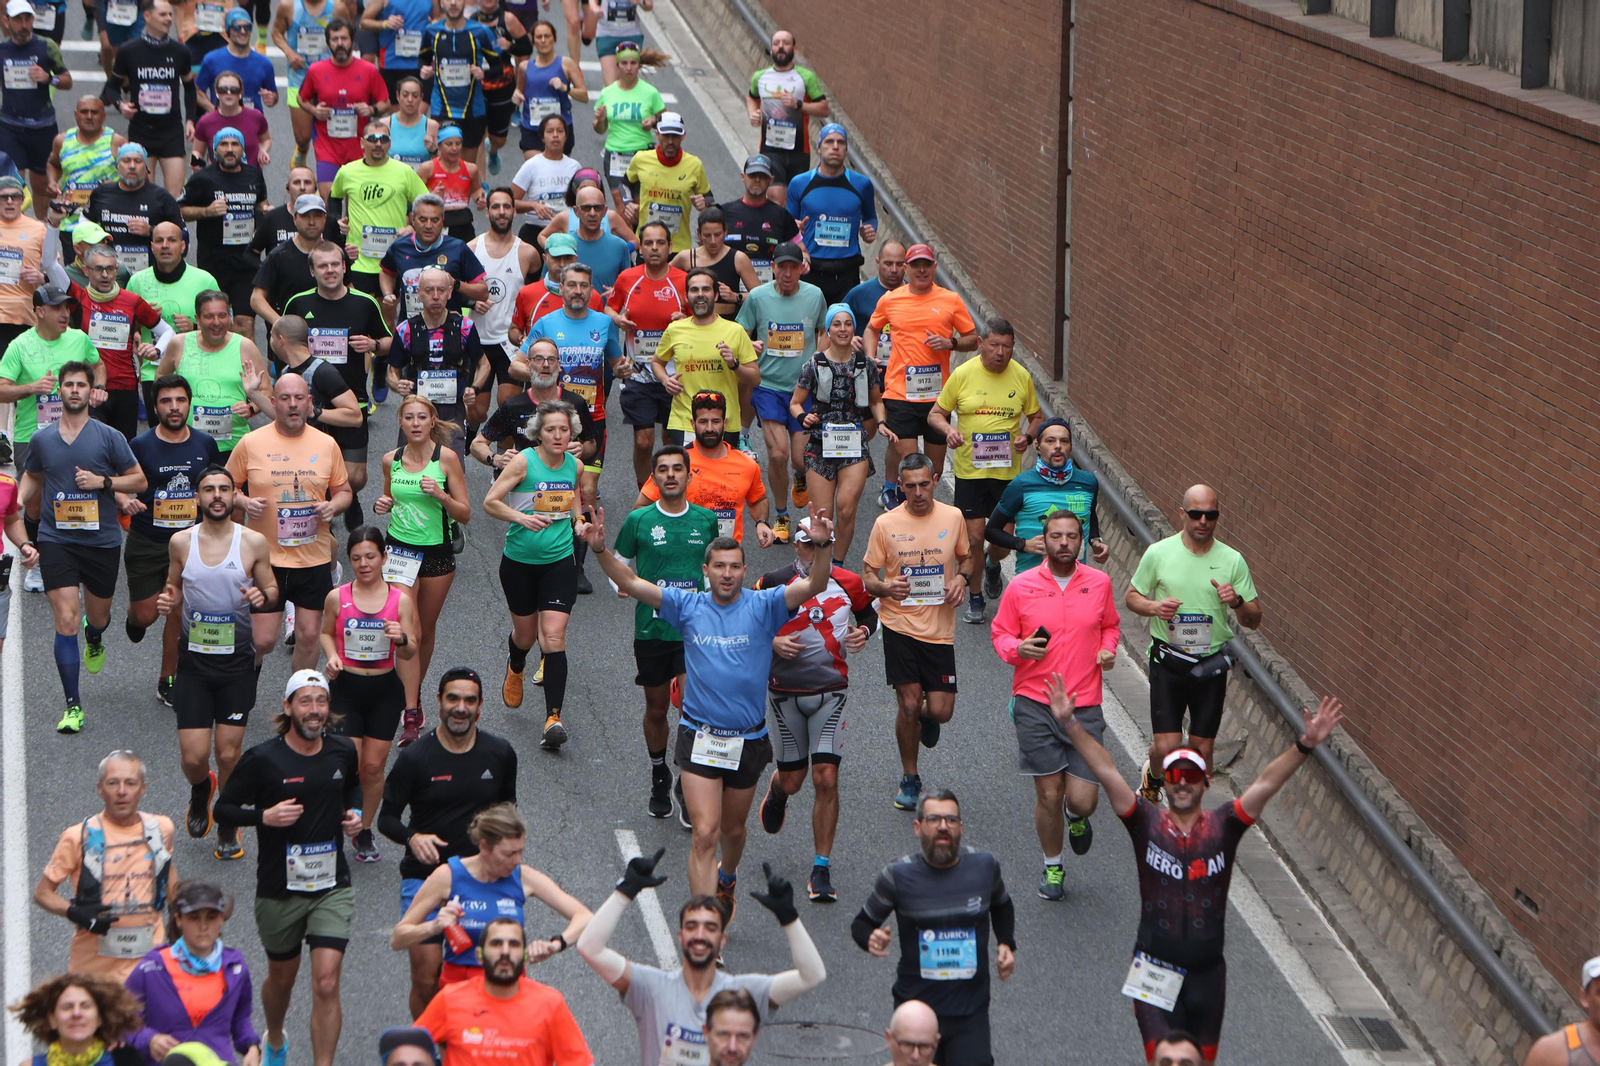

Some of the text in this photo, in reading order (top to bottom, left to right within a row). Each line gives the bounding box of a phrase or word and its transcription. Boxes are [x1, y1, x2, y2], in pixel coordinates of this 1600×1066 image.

[137, 66, 175, 80] HITACHI
[648, 190, 682, 200] SEVILLA
[104, 313, 127, 322] ZURICH
[102, 325, 117, 333] 9985
[685, 364, 724, 372] SEVILLA
[292, 521, 308, 529] 7513
[898, 549, 920, 557] Maratón
[388, 557, 408, 568] 10102
[914, 566, 940, 575] ZURICH
[669, 580, 693, 588] ZURICH
[914, 580, 931, 588] 9850
[1183, 614, 1209, 622] ZURICH
[1182, 628, 1198, 636] 8869
[359, 634, 376, 642] 8302
[692, 633, 712, 646] XVI
[712, 729, 740, 737] ZURICH
[710, 739, 727, 748] 9701
[706, 749, 729, 758] ANTONIO
[304, 843, 333, 855] ZURICH
[1145, 847, 1184, 880] HERO
[937, 931, 969, 940] ZURICH
[936, 947, 961, 956] 11146
